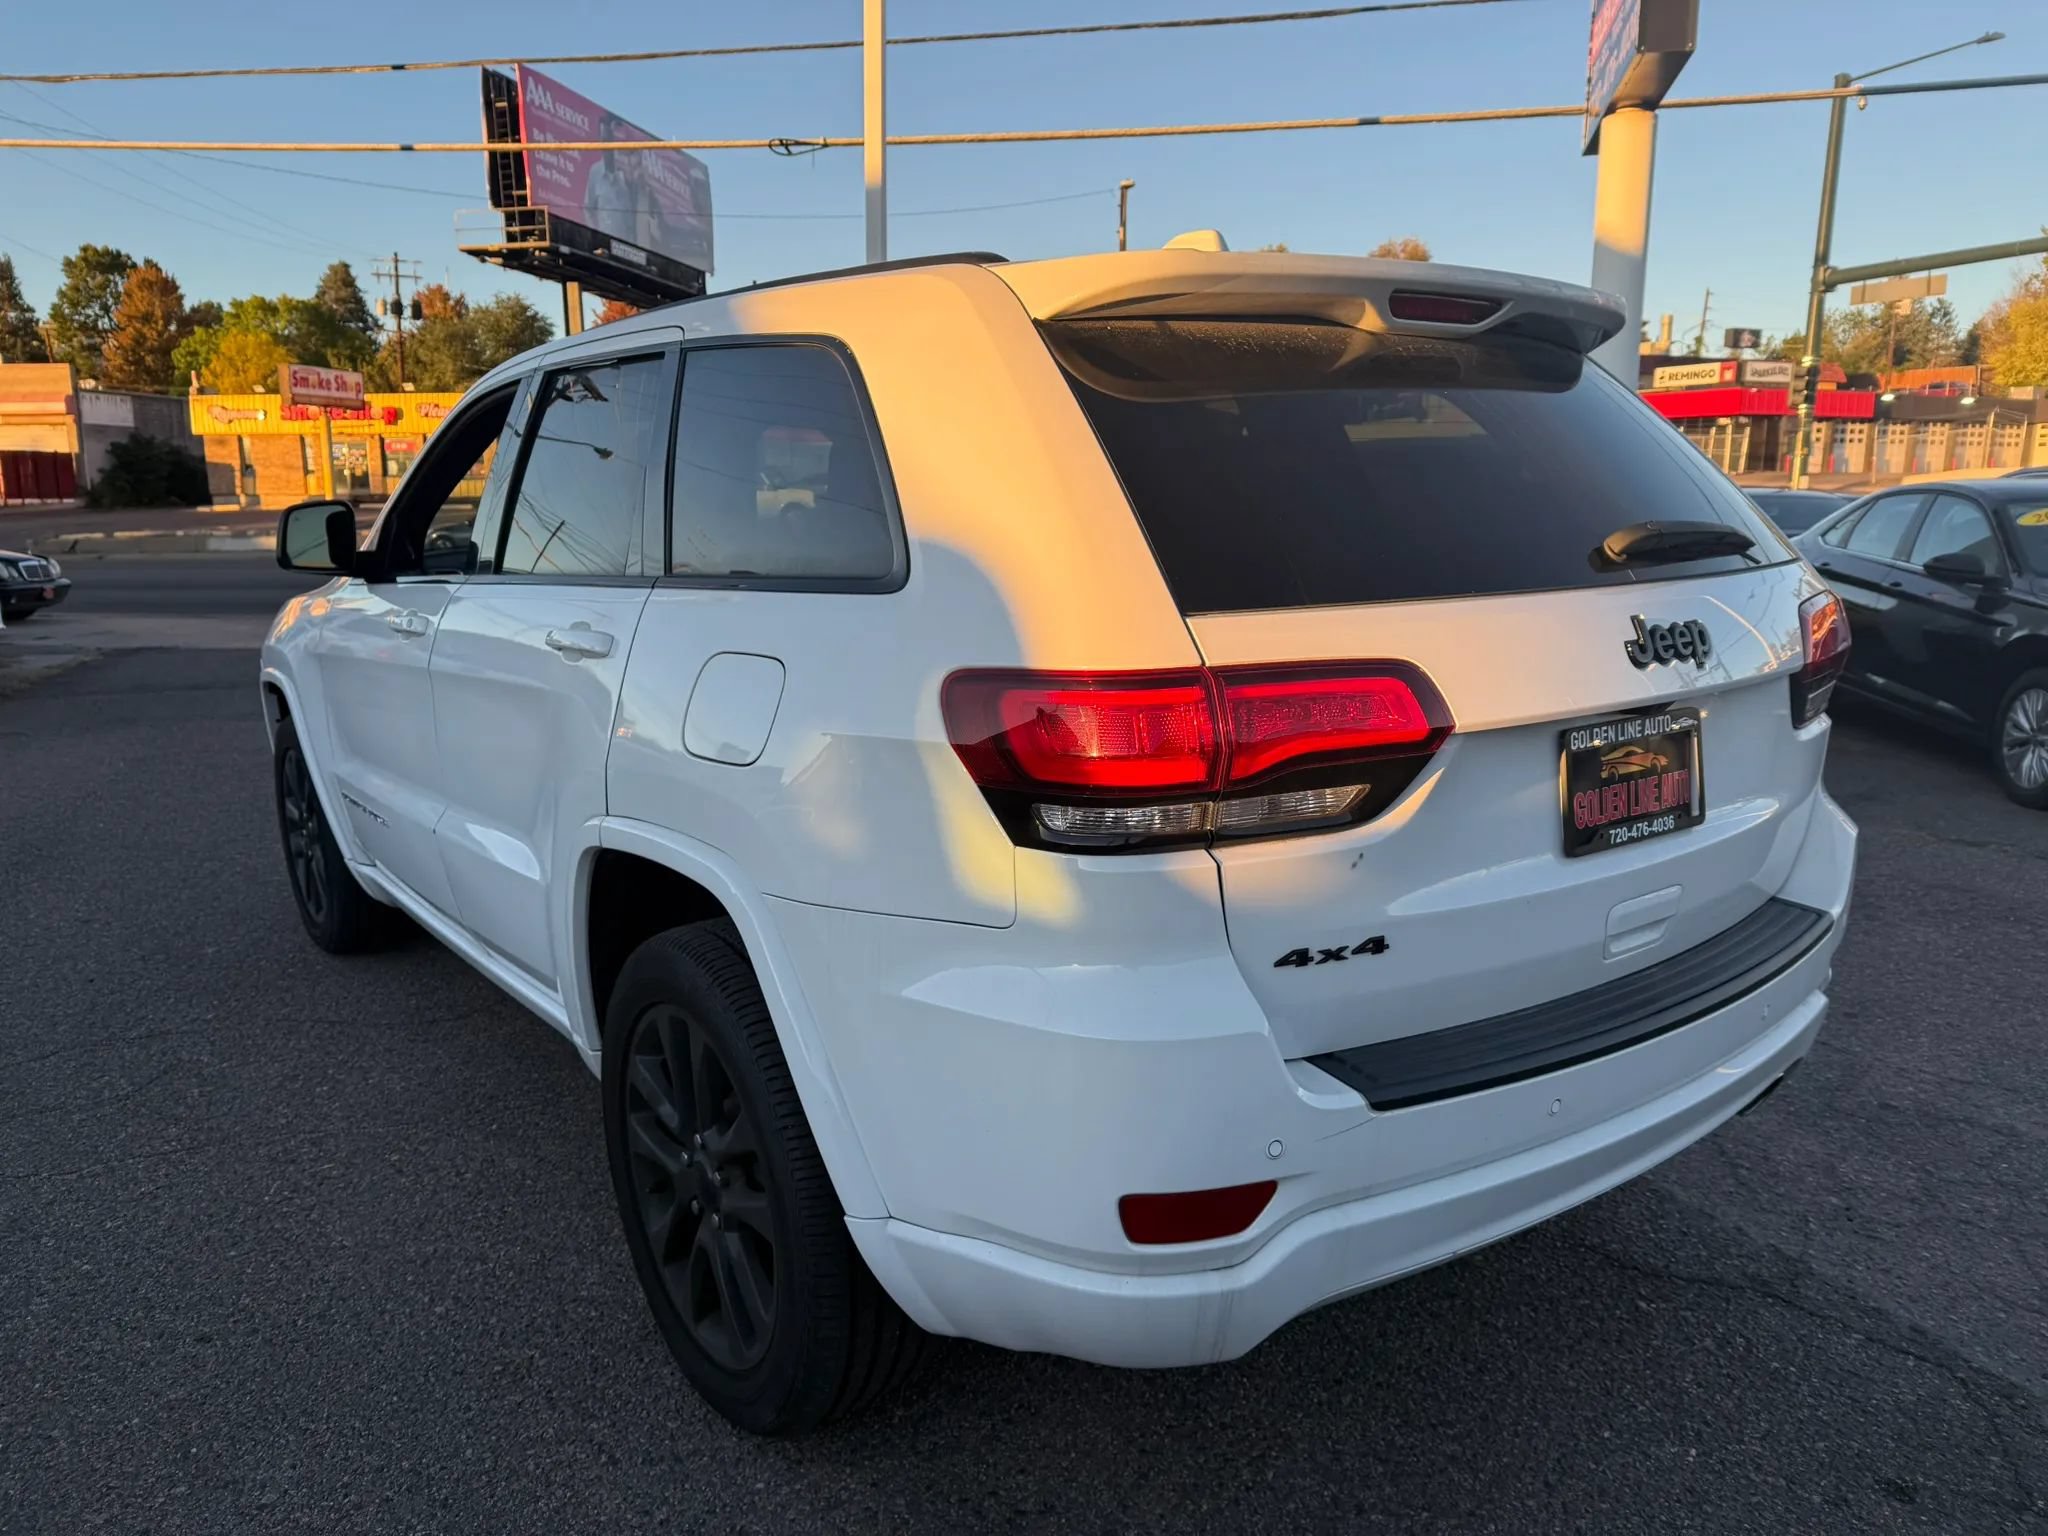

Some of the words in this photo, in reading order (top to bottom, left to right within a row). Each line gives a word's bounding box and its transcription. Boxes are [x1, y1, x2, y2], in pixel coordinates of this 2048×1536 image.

[526, 75, 555, 113] AAA
[555, 101, 591, 133] SERVICE
[292, 369, 332, 391] Smoke
[334, 374, 362, 401] Shop
[1624, 614, 1712, 671] Jeep
[1570, 725, 1616, 751] GOLDEN
[1618, 719, 1642, 742] LINE
[1644, 714, 1672, 735] AUTO
[1573, 782, 1629, 830] GOLDEN
[1630, 775, 1660, 817] LINE
[1609, 815, 1675, 844] 720-476-4036
[1273, 935, 1390, 968] 4x4
